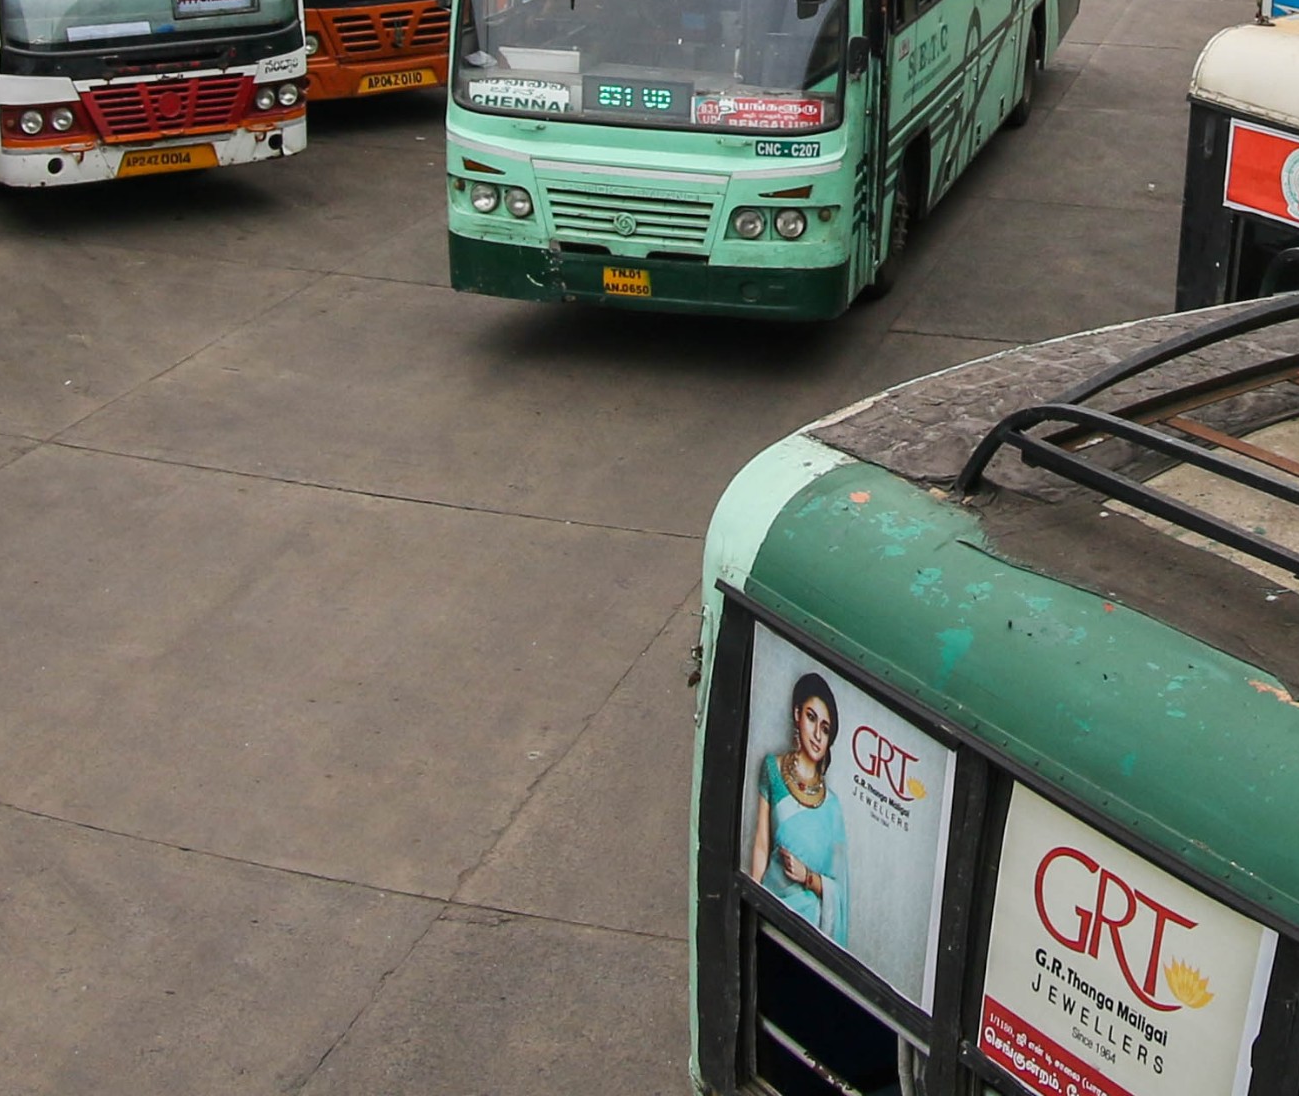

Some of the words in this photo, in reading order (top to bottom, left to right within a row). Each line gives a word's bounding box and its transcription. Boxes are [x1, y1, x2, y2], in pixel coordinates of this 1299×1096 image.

[643, 88, 671, 109] UD
[757, 142, 782, 155] CNC
[791, 144, 819, 157] C207
[852, 725, 919, 802] GRT
[852, 786, 909, 832] JEWELLERS
[1034, 846, 1198, 1011] GRT
[1031, 973, 1164, 1074] JEWELLERS
[1071, 1026, 1094, 1049] Since
[1095, 1042, 1116, 1064] 1964
